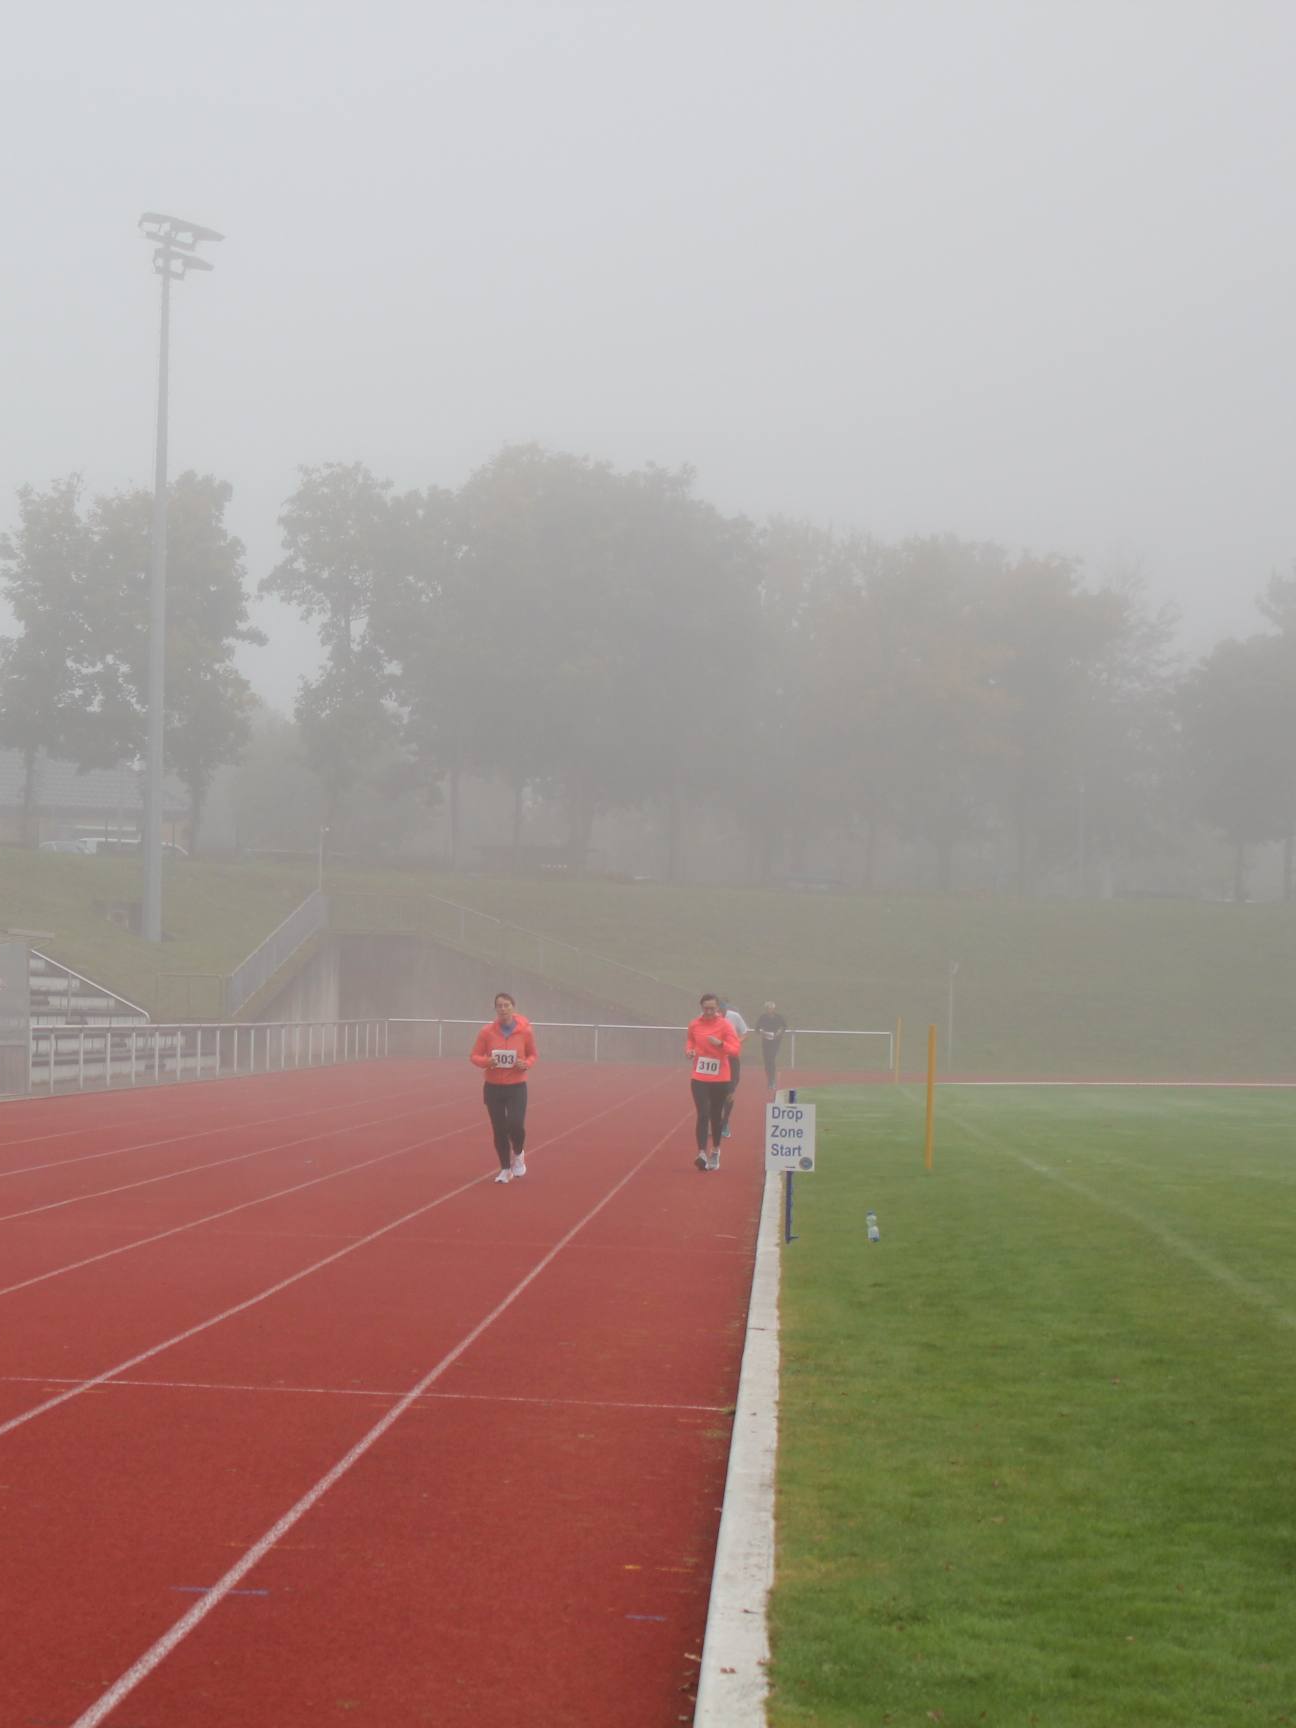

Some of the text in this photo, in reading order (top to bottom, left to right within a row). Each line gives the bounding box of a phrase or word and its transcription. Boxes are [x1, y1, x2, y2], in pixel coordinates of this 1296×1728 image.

[699, 1061, 718, 1072] 310
[772, 1107, 803, 1123] Drop
[771, 1125, 804, 1138] Zone
[771, 1143, 802, 1156] Start
